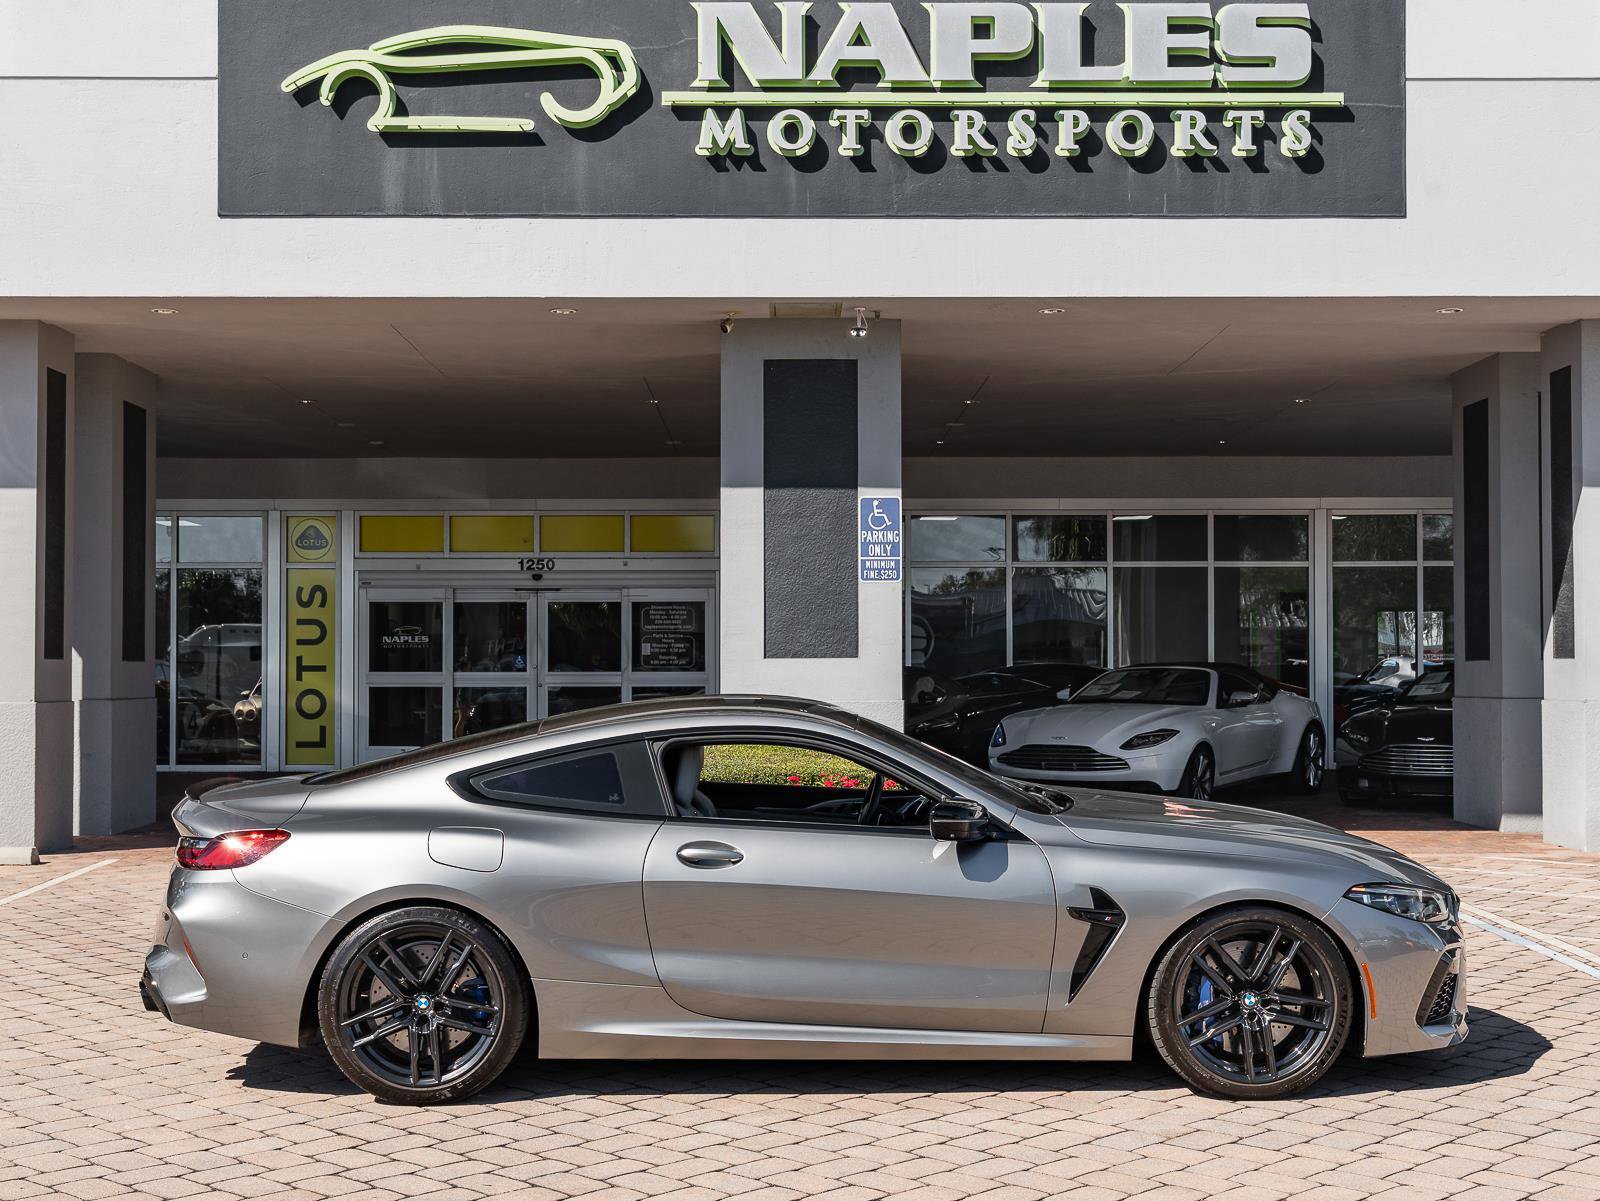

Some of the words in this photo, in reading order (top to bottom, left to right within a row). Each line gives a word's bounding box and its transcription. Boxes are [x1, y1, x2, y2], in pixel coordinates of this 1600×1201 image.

[690, 2, 1313, 88] NAPLES
[695, 107, 1313, 158] MOTORSPORTS
[297, 539, 327, 547] LOTUS
[861, 530, 900, 543] PARKING
[868, 544, 892, 557] ONLY
[518, 558, 555, 571] 1250
[865, 560, 895, 569] MINIMUM
[863, 570, 879, 579] FINE
[881, 570, 897, 580] $250
[382, 635, 430, 643] NAPLES
[295, 584, 328, 749] LOTUS
